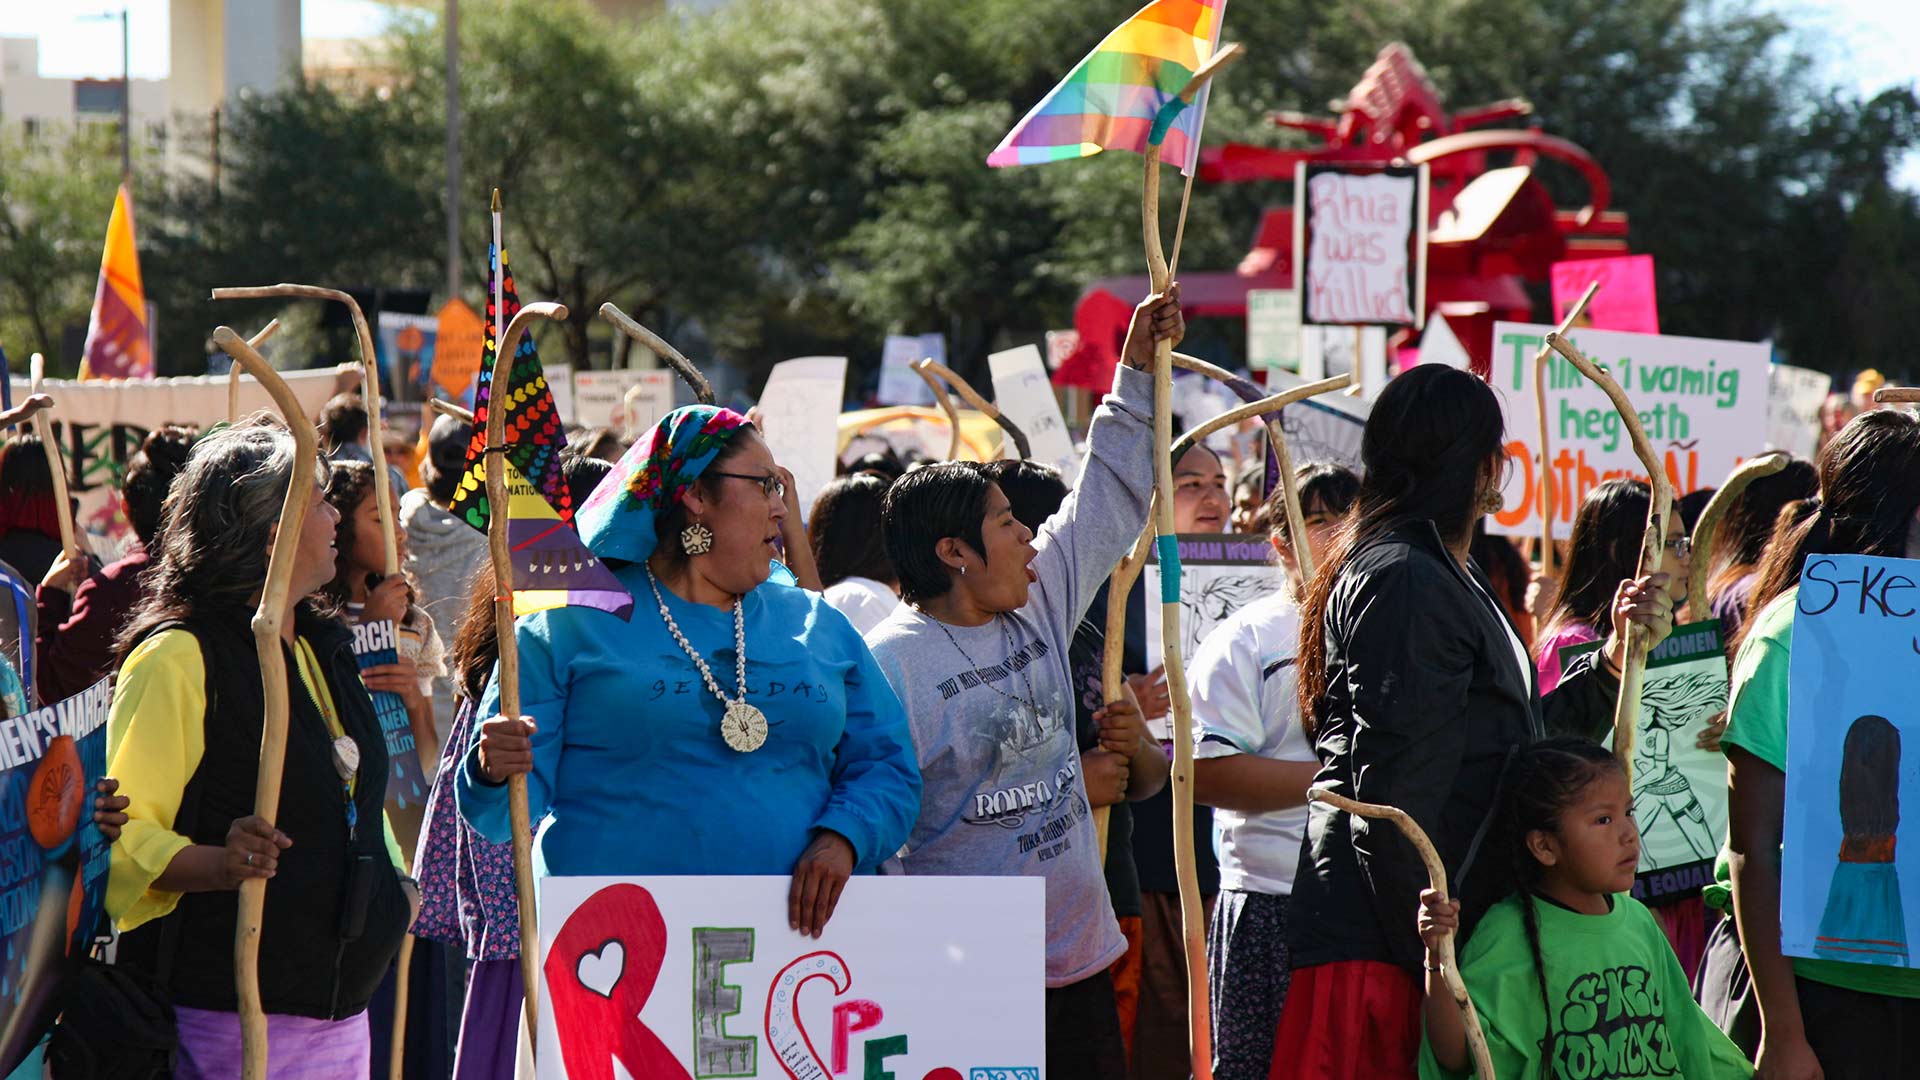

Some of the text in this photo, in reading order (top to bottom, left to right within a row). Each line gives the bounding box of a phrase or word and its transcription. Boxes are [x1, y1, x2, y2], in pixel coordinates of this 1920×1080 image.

[1310, 174, 1399, 233] Rhia
[1322, 231, 1387, 265] was
[1639, 360, 1740, 408] vamig
[351, 619, 395, 655] RCH
[1654, 630, 1719, 660] WOMEN
[56, 675, 111, 742] MARCH
